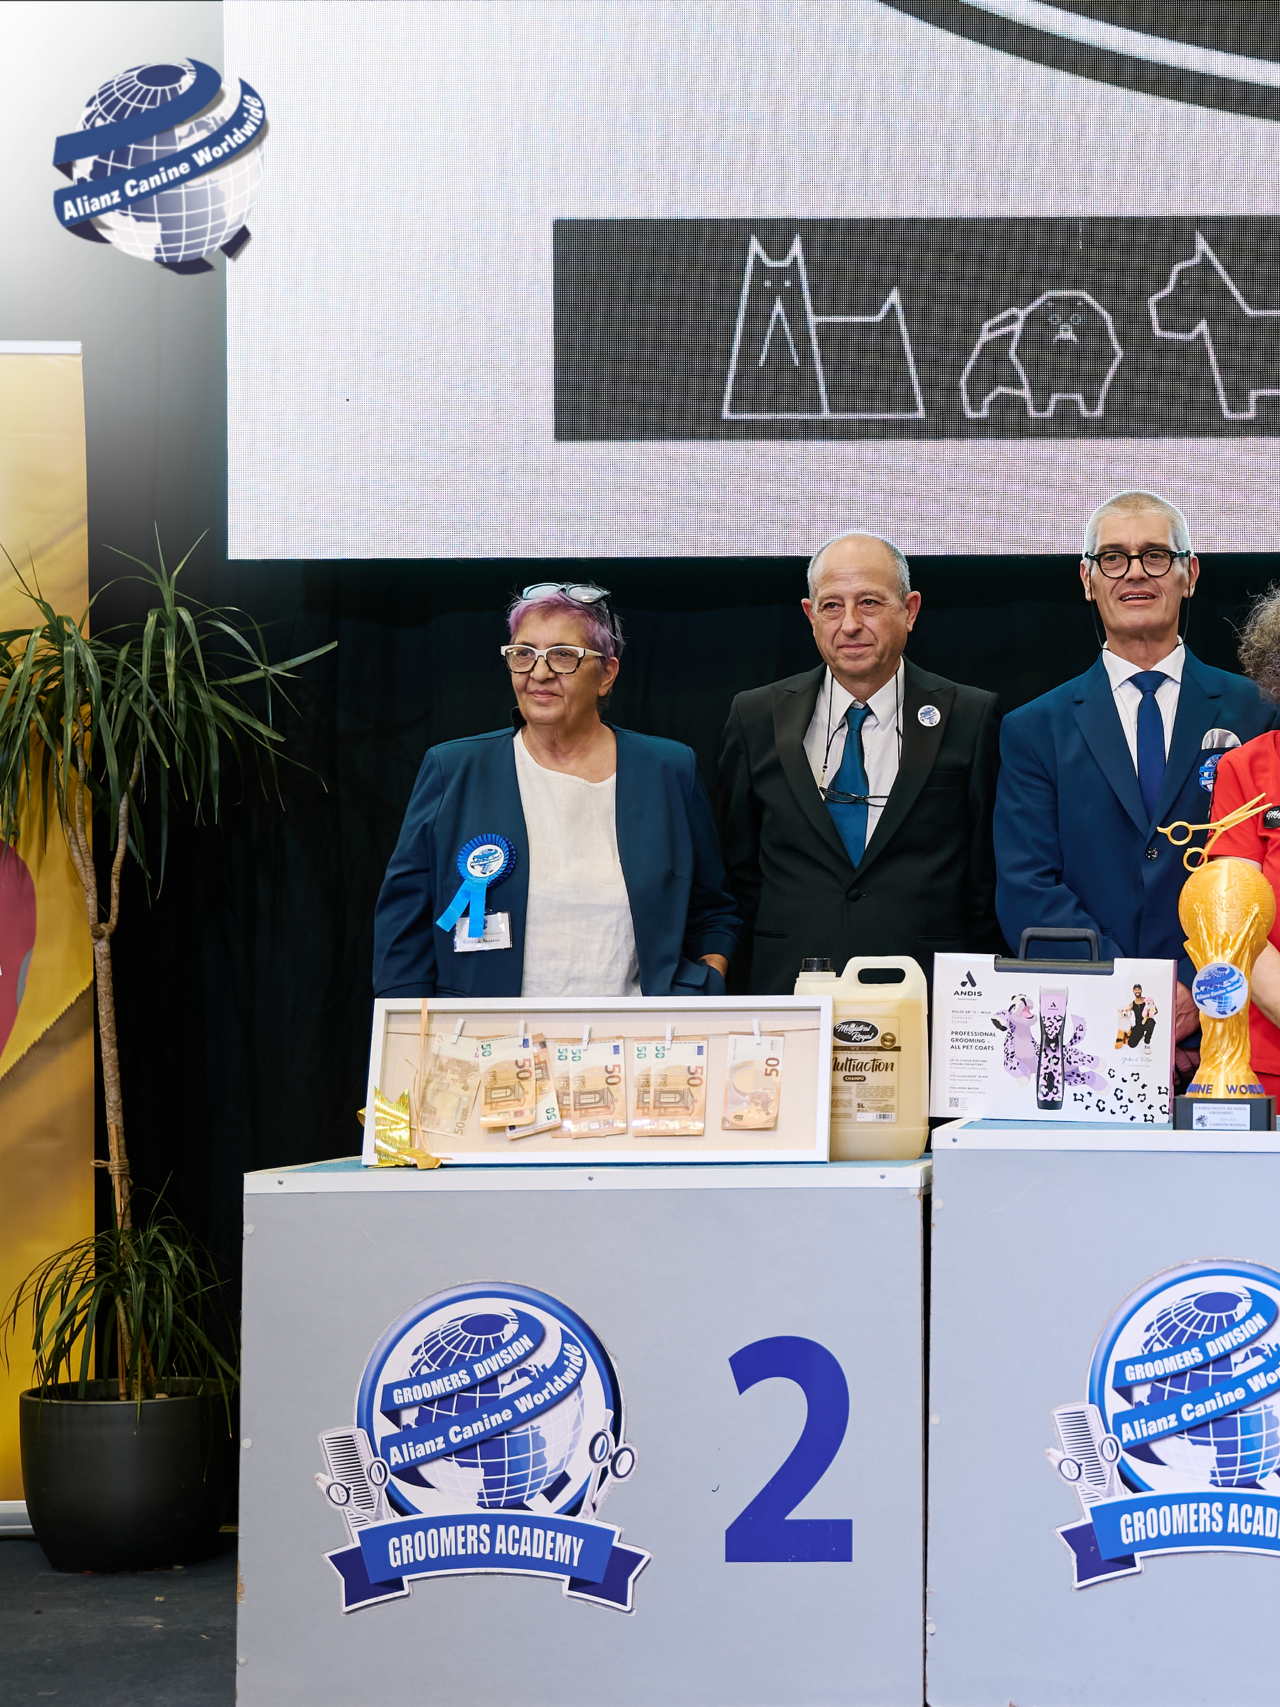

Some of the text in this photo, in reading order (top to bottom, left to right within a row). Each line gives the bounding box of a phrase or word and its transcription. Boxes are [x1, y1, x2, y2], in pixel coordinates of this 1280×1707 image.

[835, 1023, 872, 1035] Magistral
[851, 1032, 875, 1042] Royal
[481, 1043, 492, 1057] 50
[557, 1048, 568, 1061] 50
[571, 1049, 582, 1062] 50
[636, 1046, 647, 1059] 50
[655, 1046, 666, 1059] 50
[515, 1058, 533, 1081] 50
[605, 1064, 622, 1086] 50
[687, 1065, 704, 1087] 50
[764, 1057, 780, 1077] 50
[546, 1107, 557, 1121] 50
[454, 1121, 466, 1135] 50
[1125, 1313, 1268, 1382] GROOMERS DIVISION
[393, 1335, 534, 1405] GROOMERS DIVISION
[389, 1343, 585, 1466] Alianz Canine Worldwide
[1121, 1413, 1178, 1444] Alianz
[1180, 1387, 1246, 1421] Canine
[725, 1335, 853, 1563] 2
[1120, 1502, 1223, 1545] GROOMERS
[388, 1523, 585, 1568] GROOMERS ACADEMY
